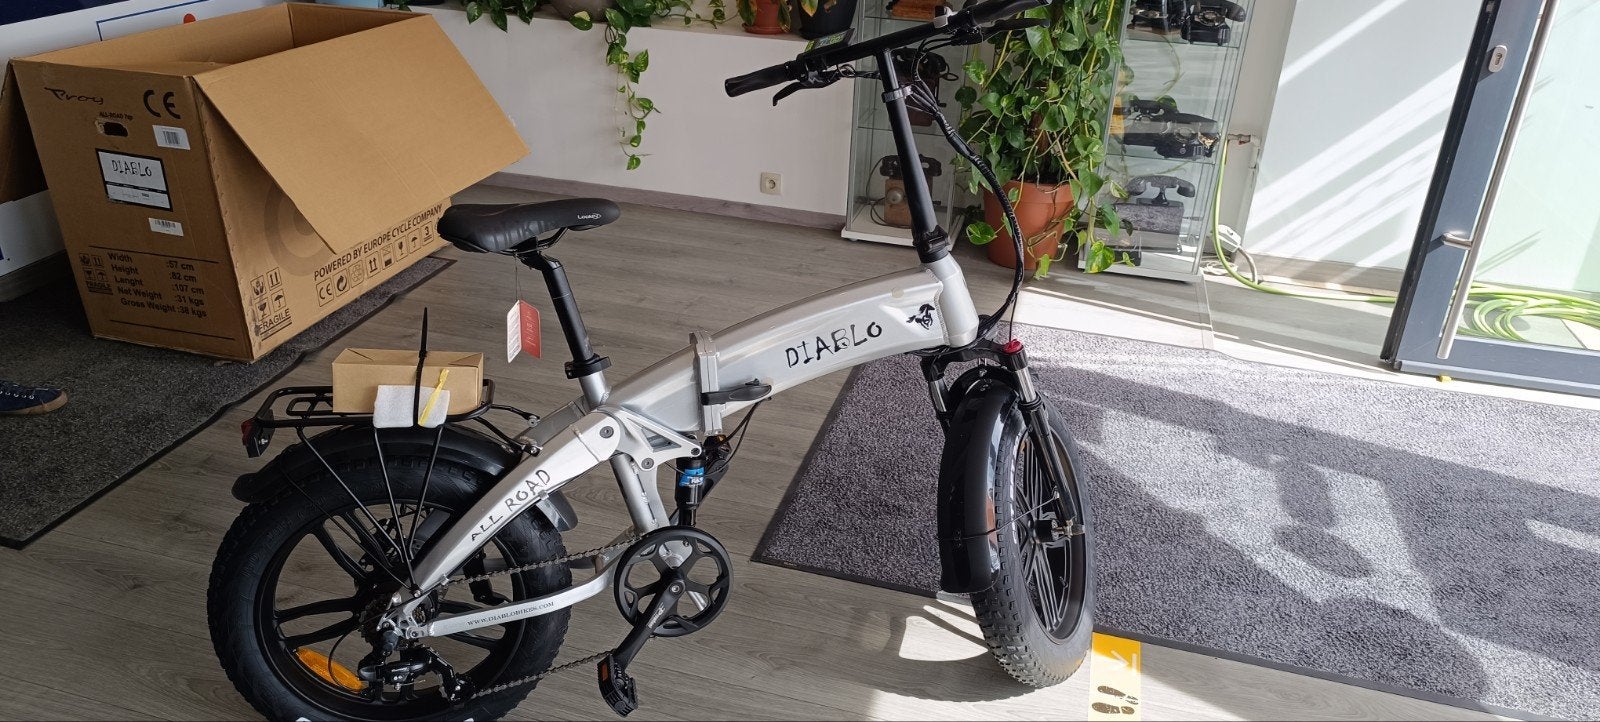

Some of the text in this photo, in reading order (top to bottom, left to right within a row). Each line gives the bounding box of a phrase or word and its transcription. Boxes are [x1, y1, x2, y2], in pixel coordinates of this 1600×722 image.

[143, 89, 182, 119] CE
[111, 160, 152, 177] DIABLO
[313, 203, 443, 281] POWERED BY EUROPE CYCLE COMPANY
[107, 252, 195, 271] Width :57 cm
[111, 264, 197, 283] Height :82 cm
[114, 275, 205, 295] Lenght :107 cm
[318, 280, 333, 300] CE
[118, 287, 132, 296] Net
[134, 289, 162, 301] Weight
[189, 296, 205, 307] kgs
[120, 298, 145, 309] Gross
[147, 301, 176, 313] Weight
[191, 307, 208, 318] kgs
[258, 308, 290, 332] FRAGILE
[785, 321, 883, 368] DIABLO
[470, 469, 551, 542] ALL ROAD
[466, 601, 554, 627] WWW.DIABLOBIKES.COM
